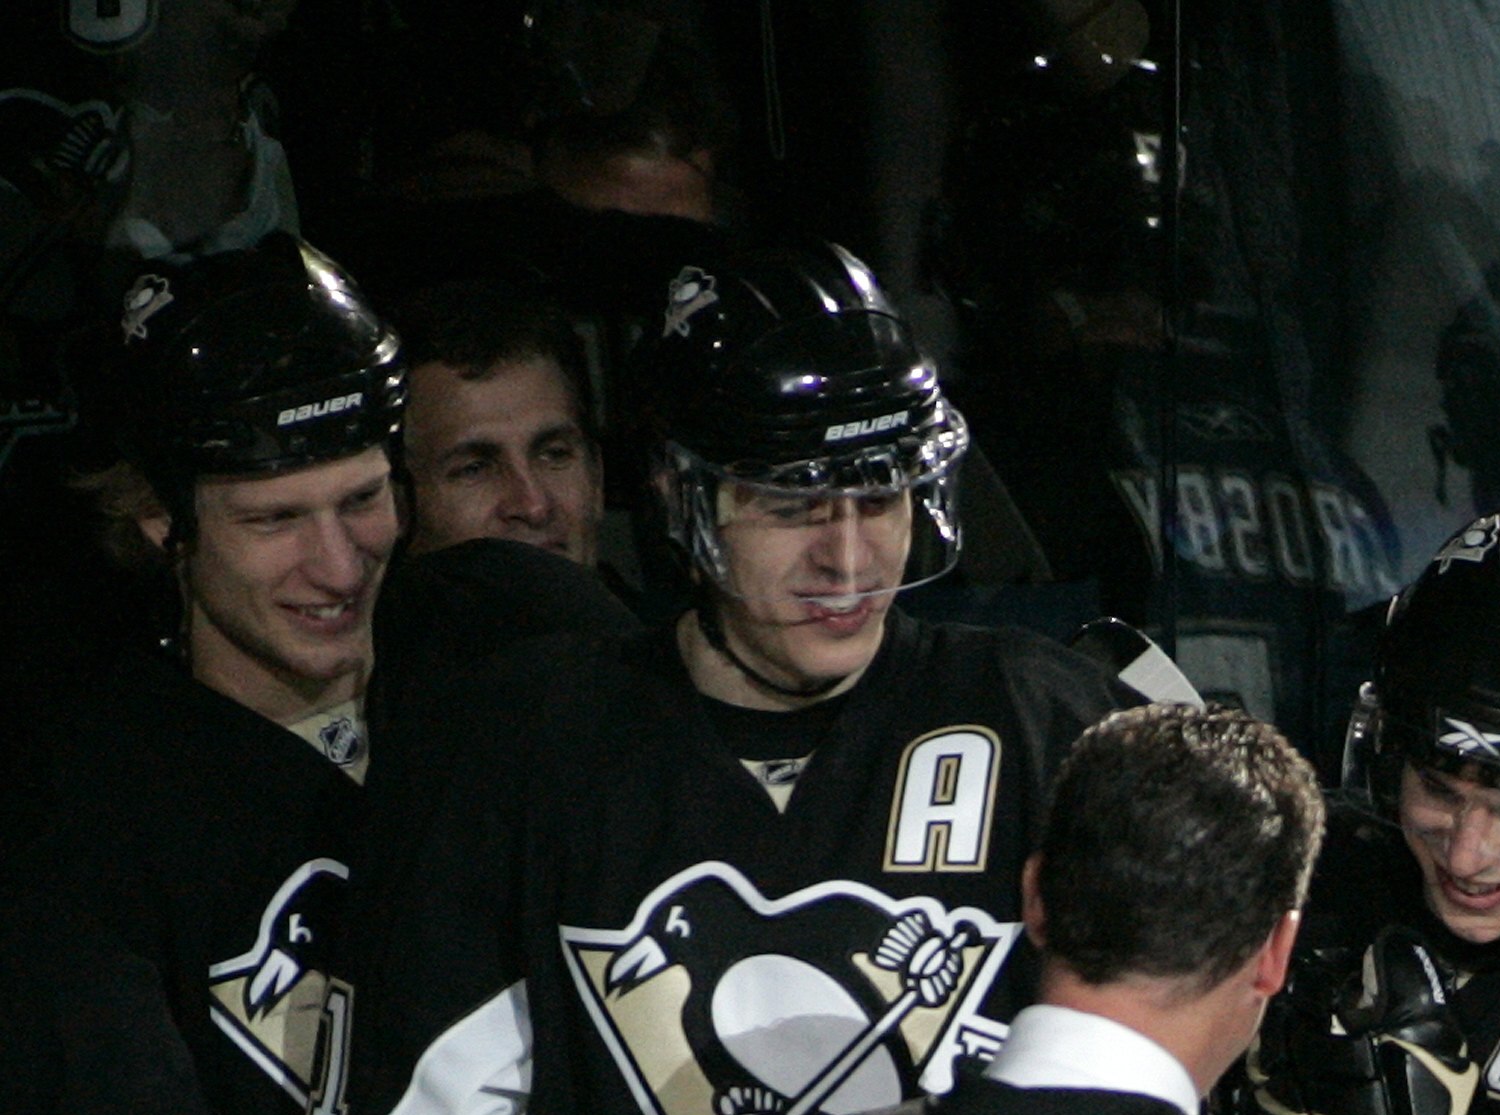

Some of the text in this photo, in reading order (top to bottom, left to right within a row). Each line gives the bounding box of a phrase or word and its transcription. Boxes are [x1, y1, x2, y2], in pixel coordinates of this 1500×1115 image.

[276, 391, 363, 426] BAUER
[825, 410, 910, 442] BAUER
[881, 725, 1000, 873] A
